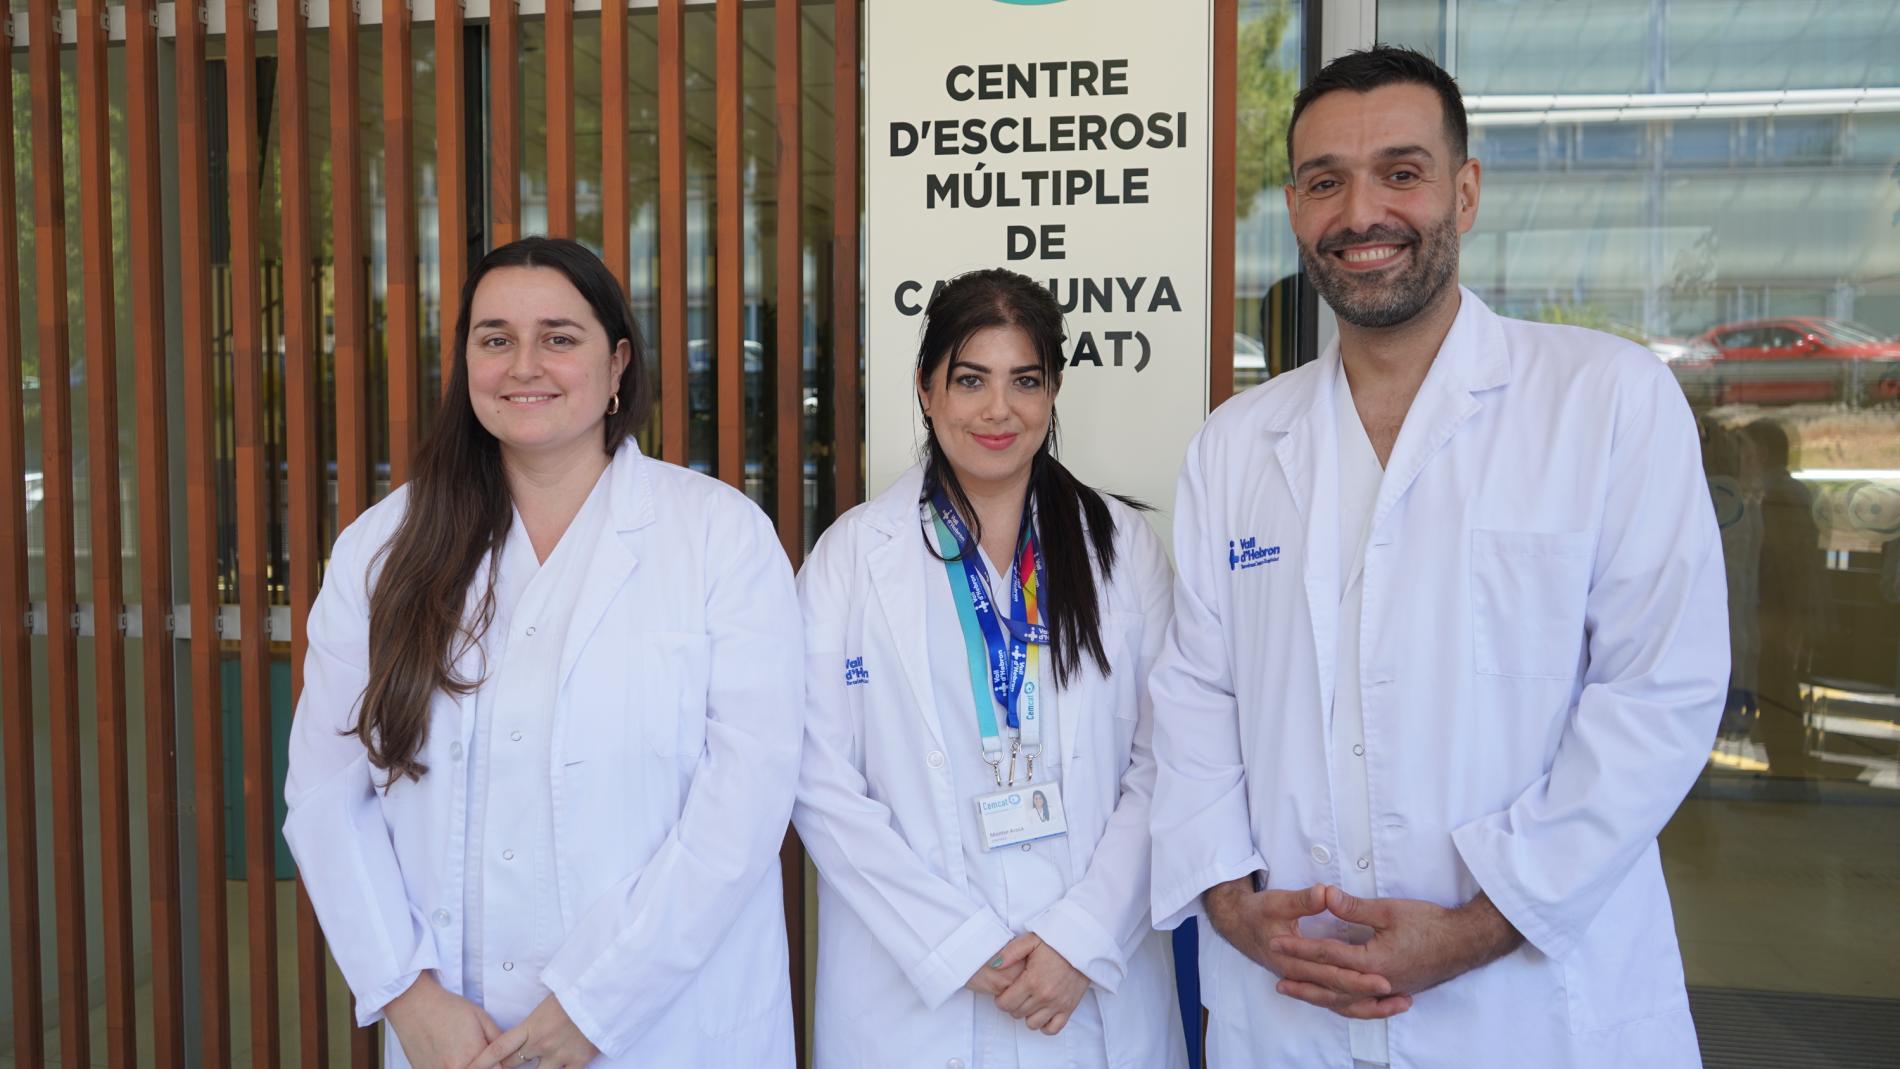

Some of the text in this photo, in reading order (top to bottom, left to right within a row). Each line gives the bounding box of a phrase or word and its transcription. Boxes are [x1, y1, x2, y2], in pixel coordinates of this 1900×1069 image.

[946, 59, 1128, 101] CENTRE
[890, 112, 1187, 157] D'ESCLEROSI
[926, 162, 1149, 209] MÚLTIPLE
[1007, 224, 1066, 260] DE
[1240, 537, 1255, 550] Vall
[1241, 546, 1280, 562] d'Hebron
